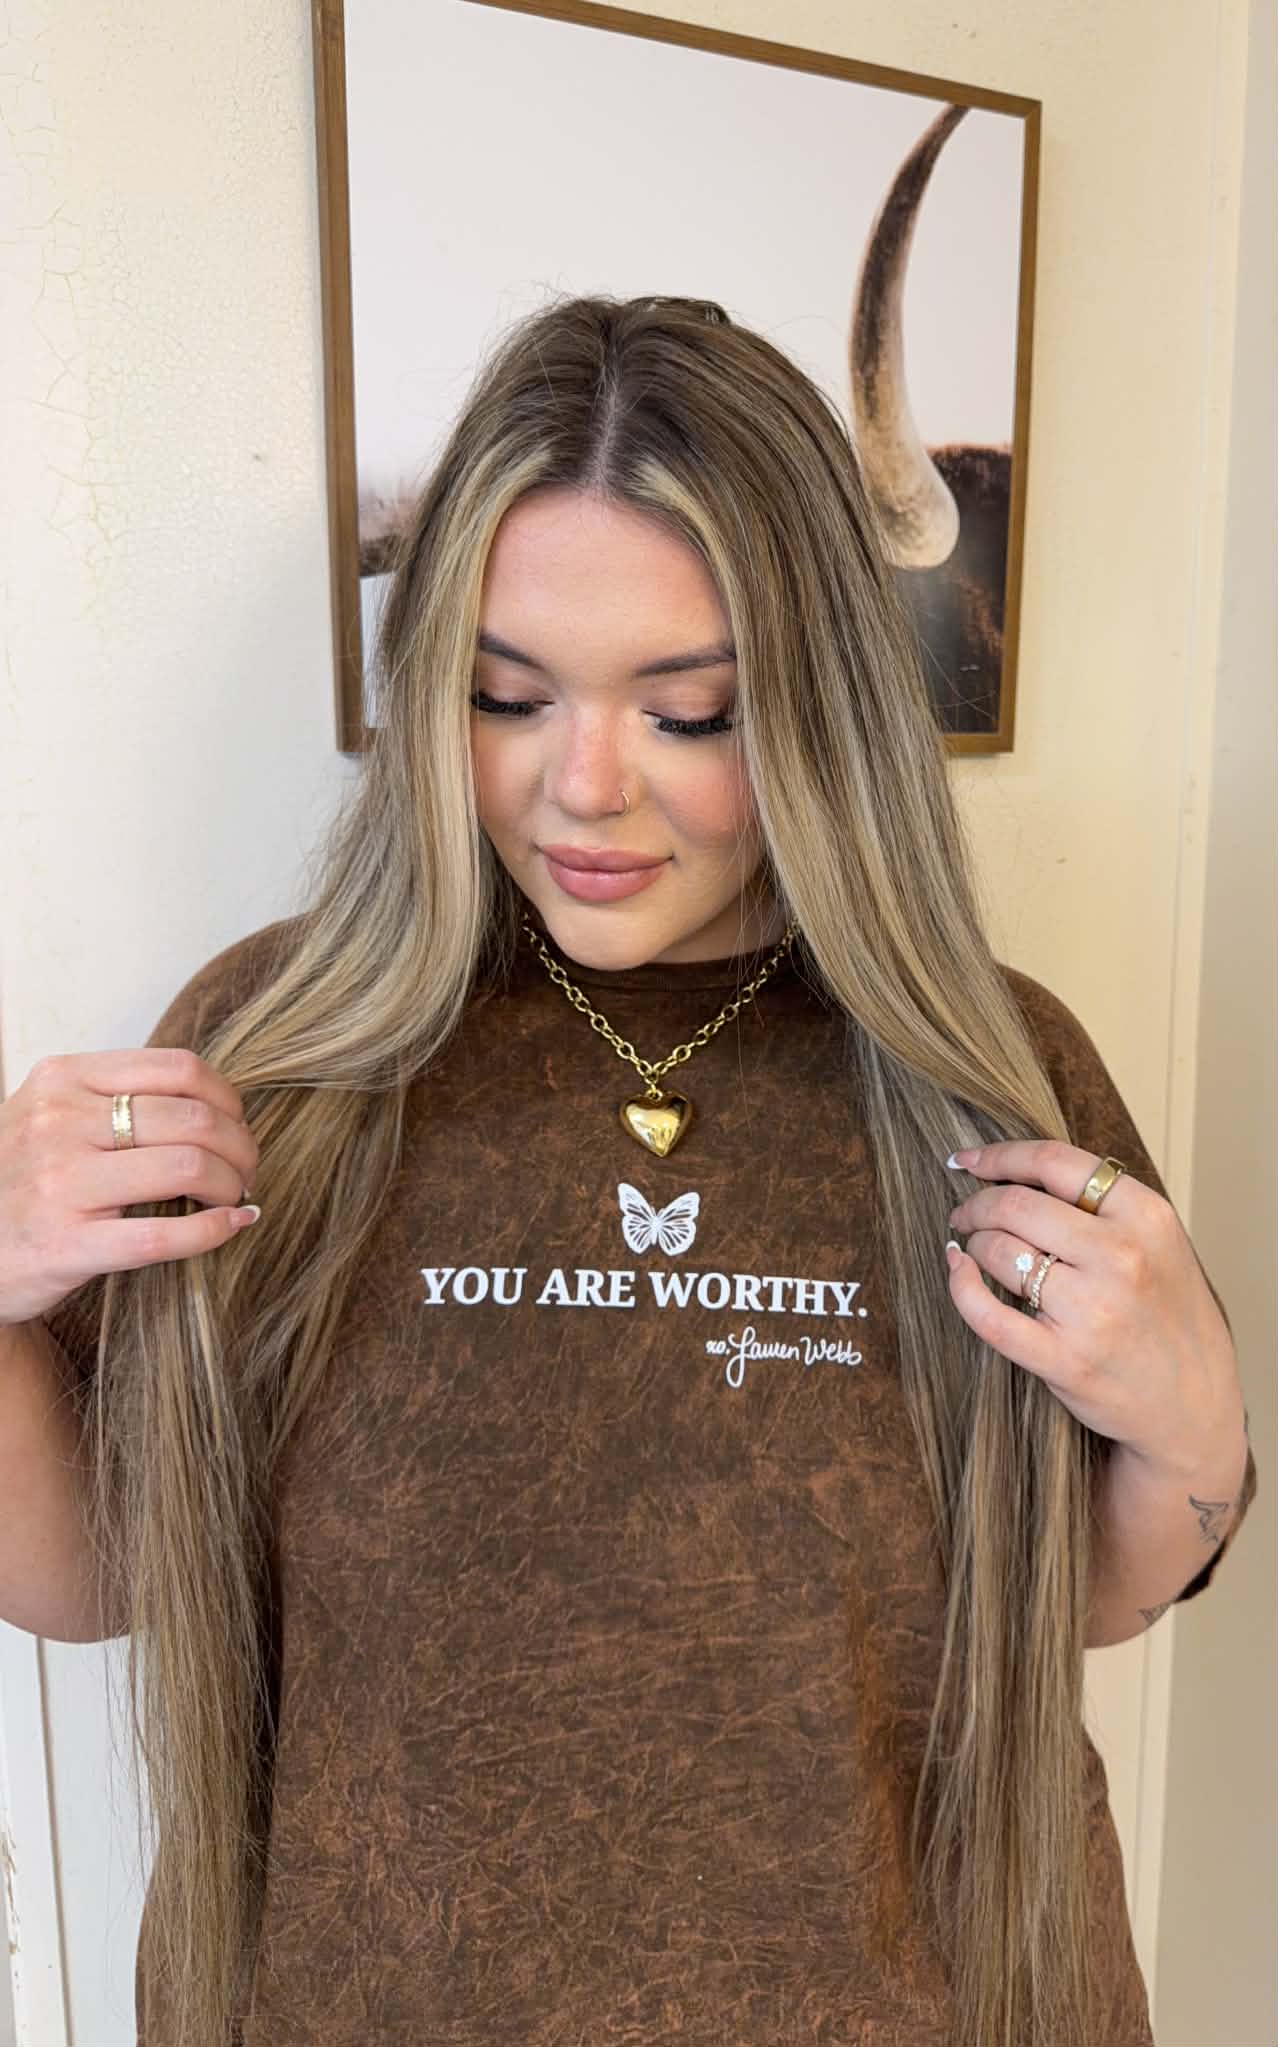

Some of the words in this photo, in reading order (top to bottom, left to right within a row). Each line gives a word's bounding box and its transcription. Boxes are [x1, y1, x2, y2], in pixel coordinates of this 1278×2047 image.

[420, 1266, 528, 1305] YOU
[535, 1268, 636, 1308] ARE
[647, 1271, 868, 1318] WORTHY.
[799, 1336, 862, 1366] Webb
